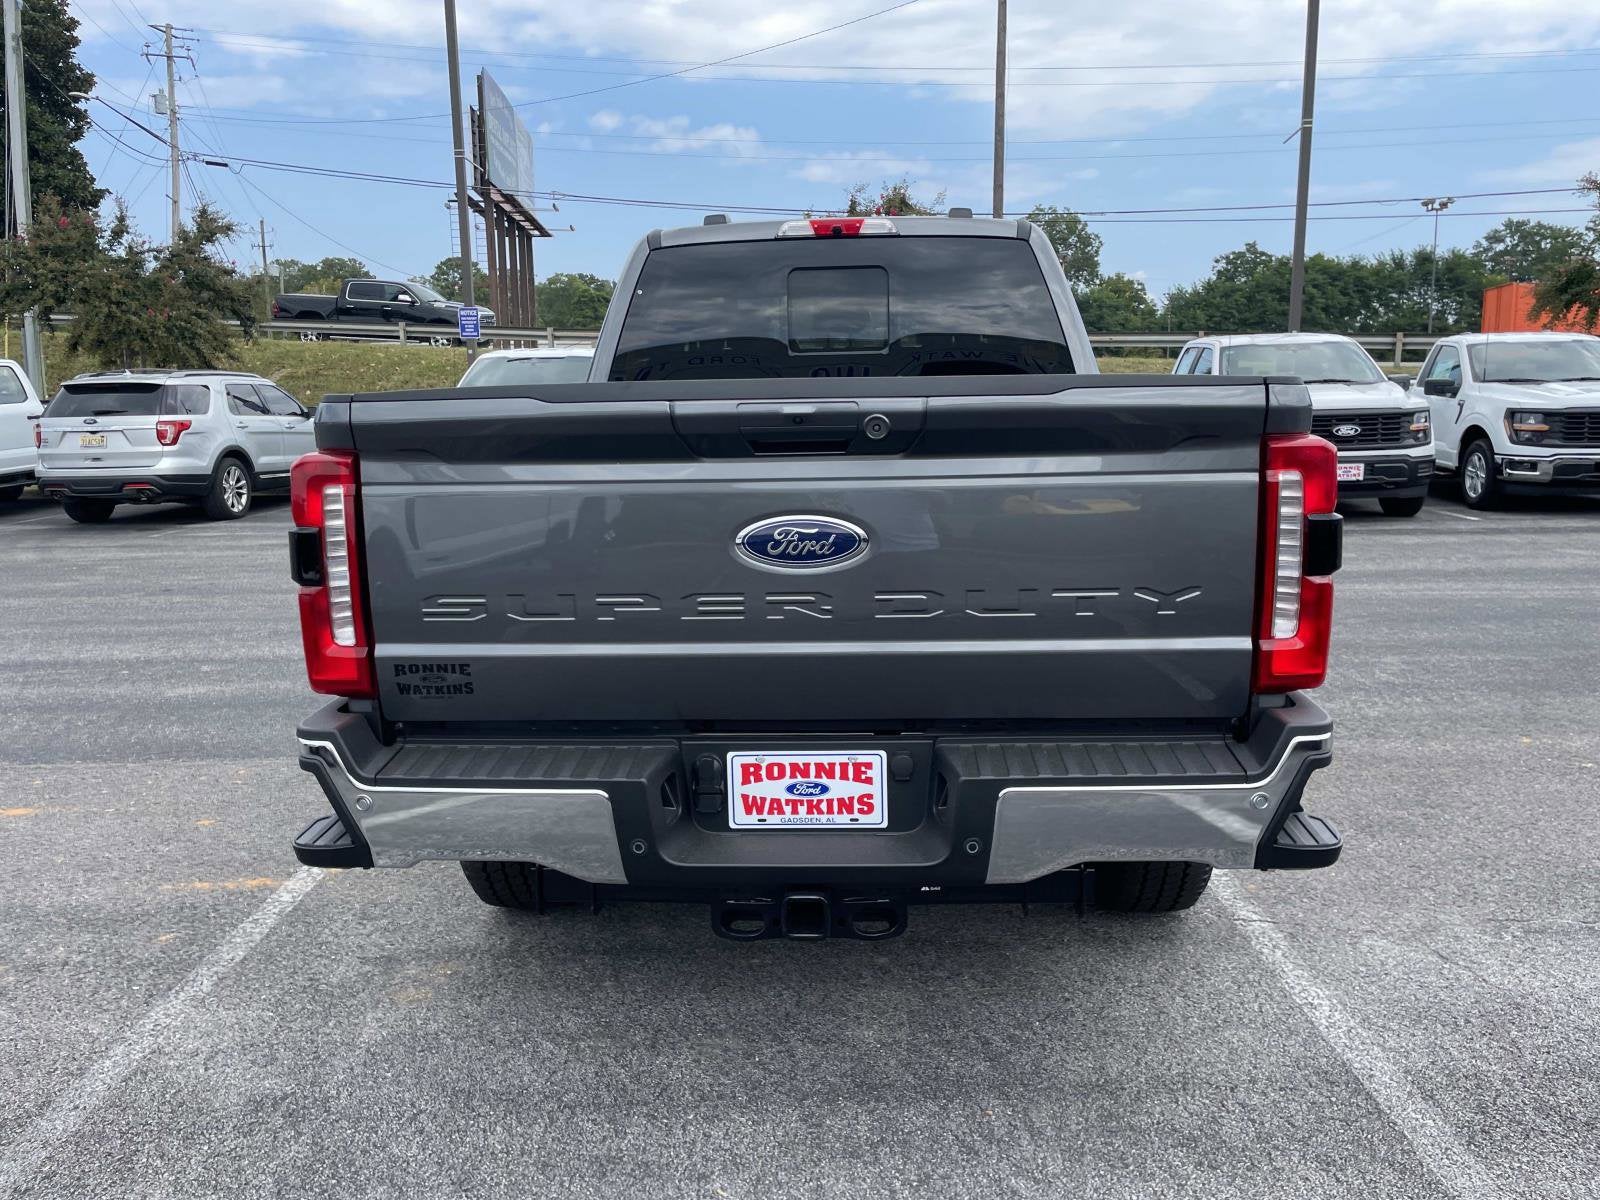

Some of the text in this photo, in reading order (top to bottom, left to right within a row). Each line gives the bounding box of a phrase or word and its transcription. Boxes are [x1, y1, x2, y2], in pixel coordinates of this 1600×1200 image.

[767, 527, 836, 556] Ford
[421, 586, 1202, 621] SUPER DUTY
[393, 663, 472, 677] RONNIE
[396, 681, 474, 696] WATKINS
[740, 761, 874, 786] RONNIE
[793, 783, 821, 795] Ford
[741, 793, 875, 816] WATKINS
